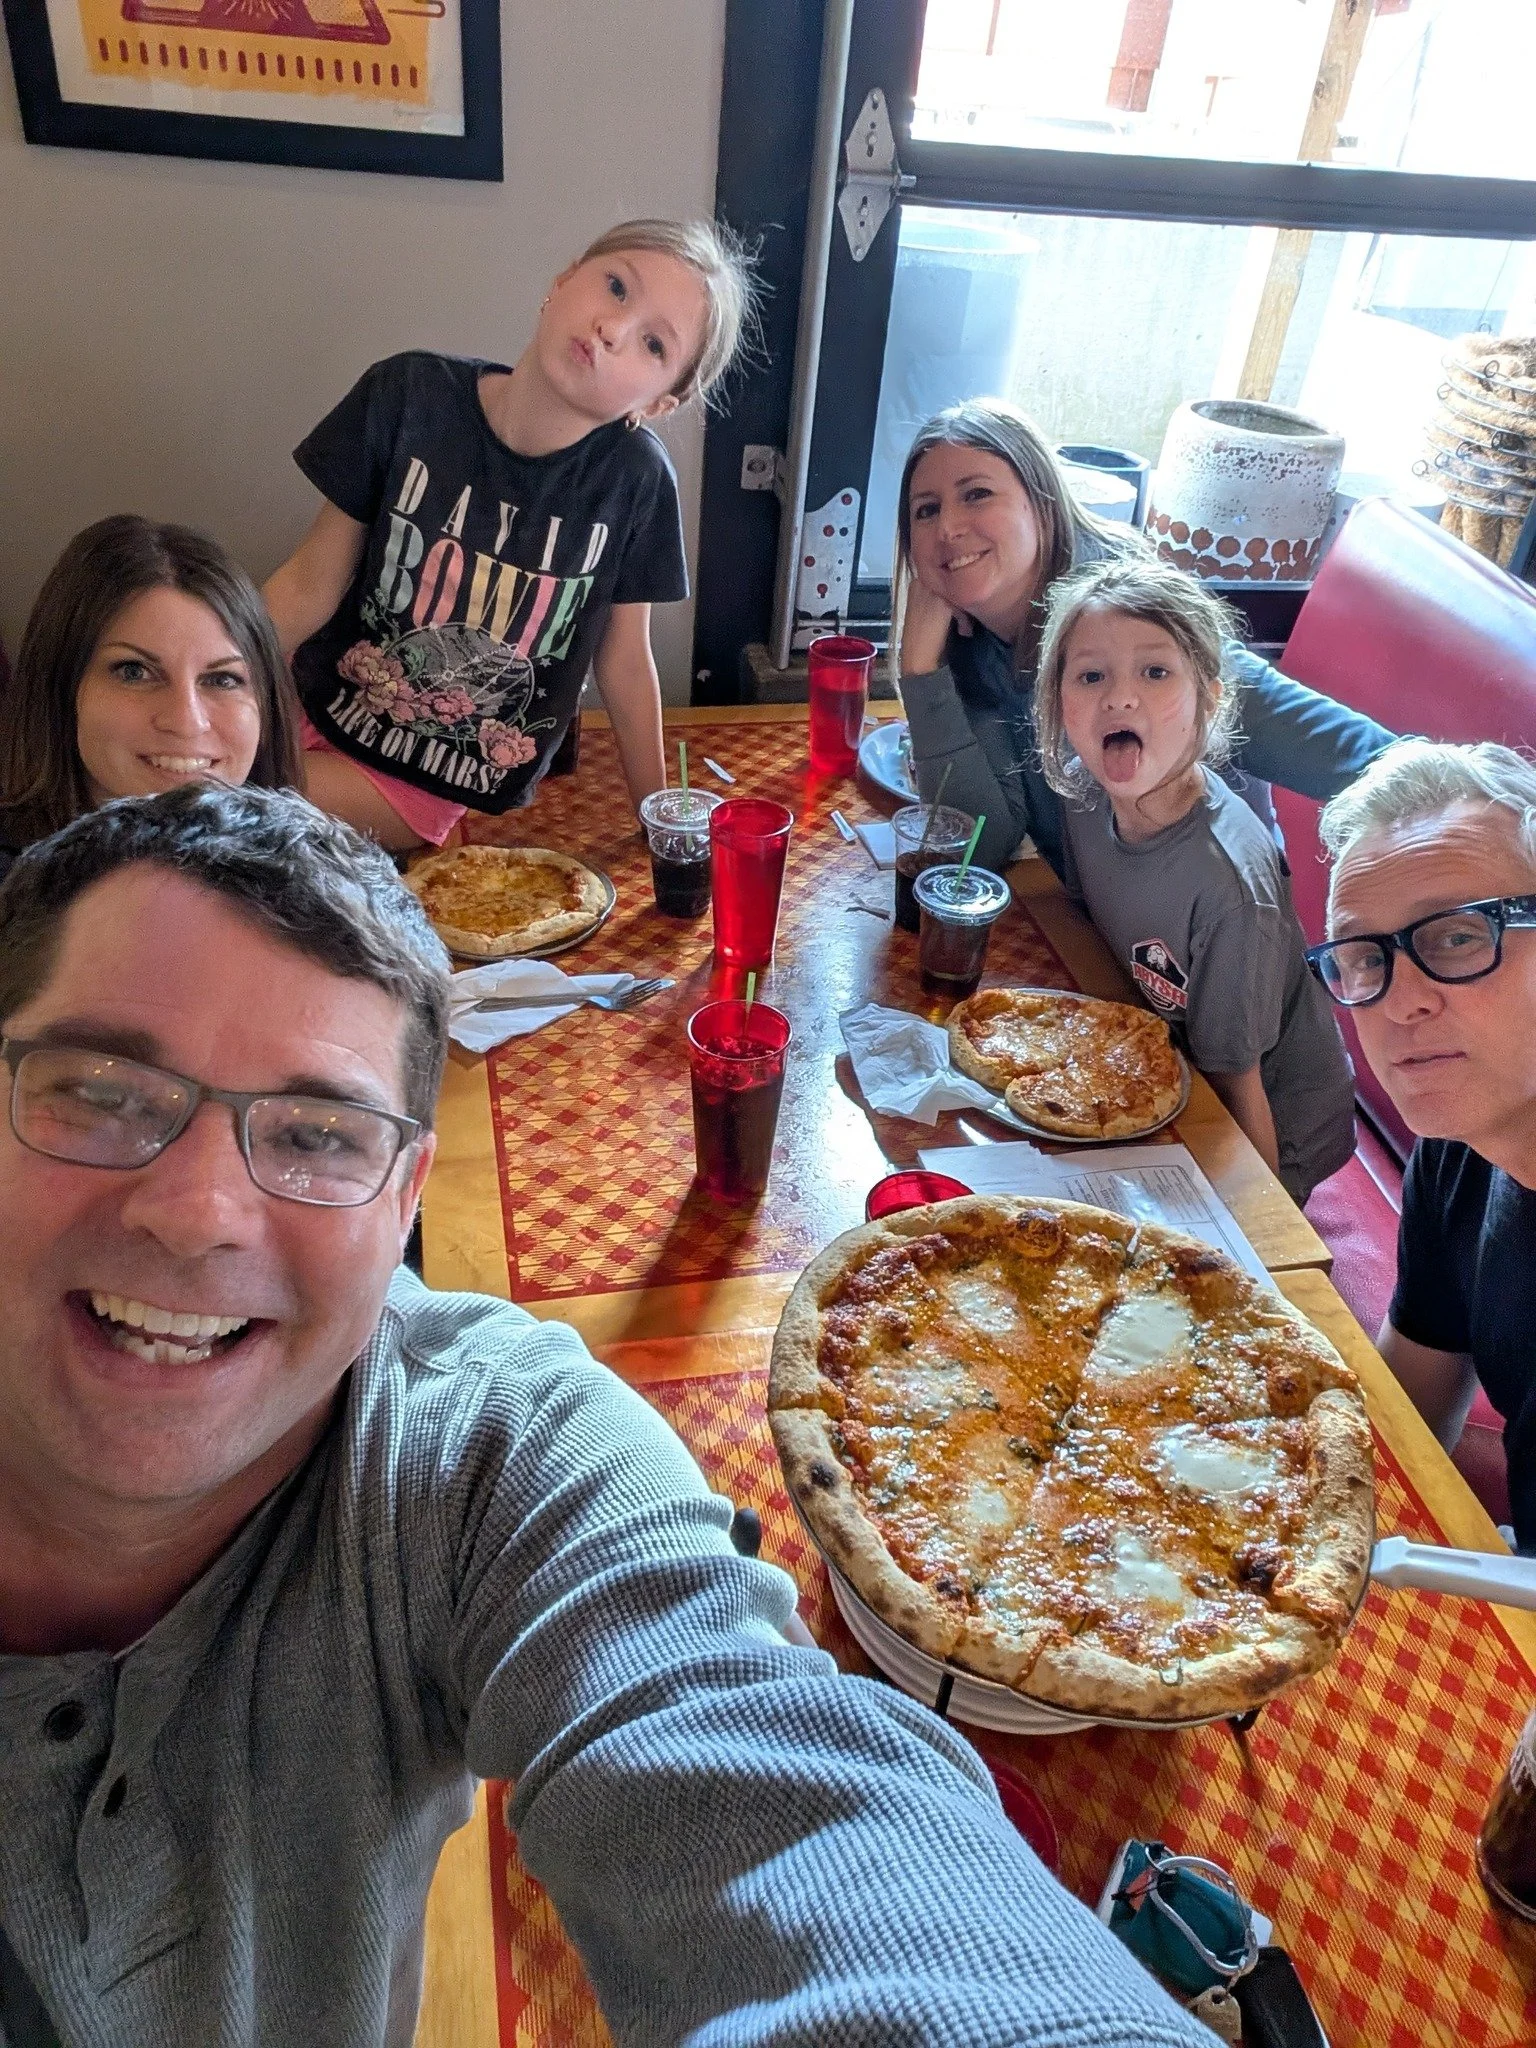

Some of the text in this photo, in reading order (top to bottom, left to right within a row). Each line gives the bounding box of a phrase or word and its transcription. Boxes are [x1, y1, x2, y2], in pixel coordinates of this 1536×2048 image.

[394, 456, 609, 575] DAVID
[377, 512, 595, 661] BOWIE
[326, 687, 508, 794] LIFE ON MARS?
